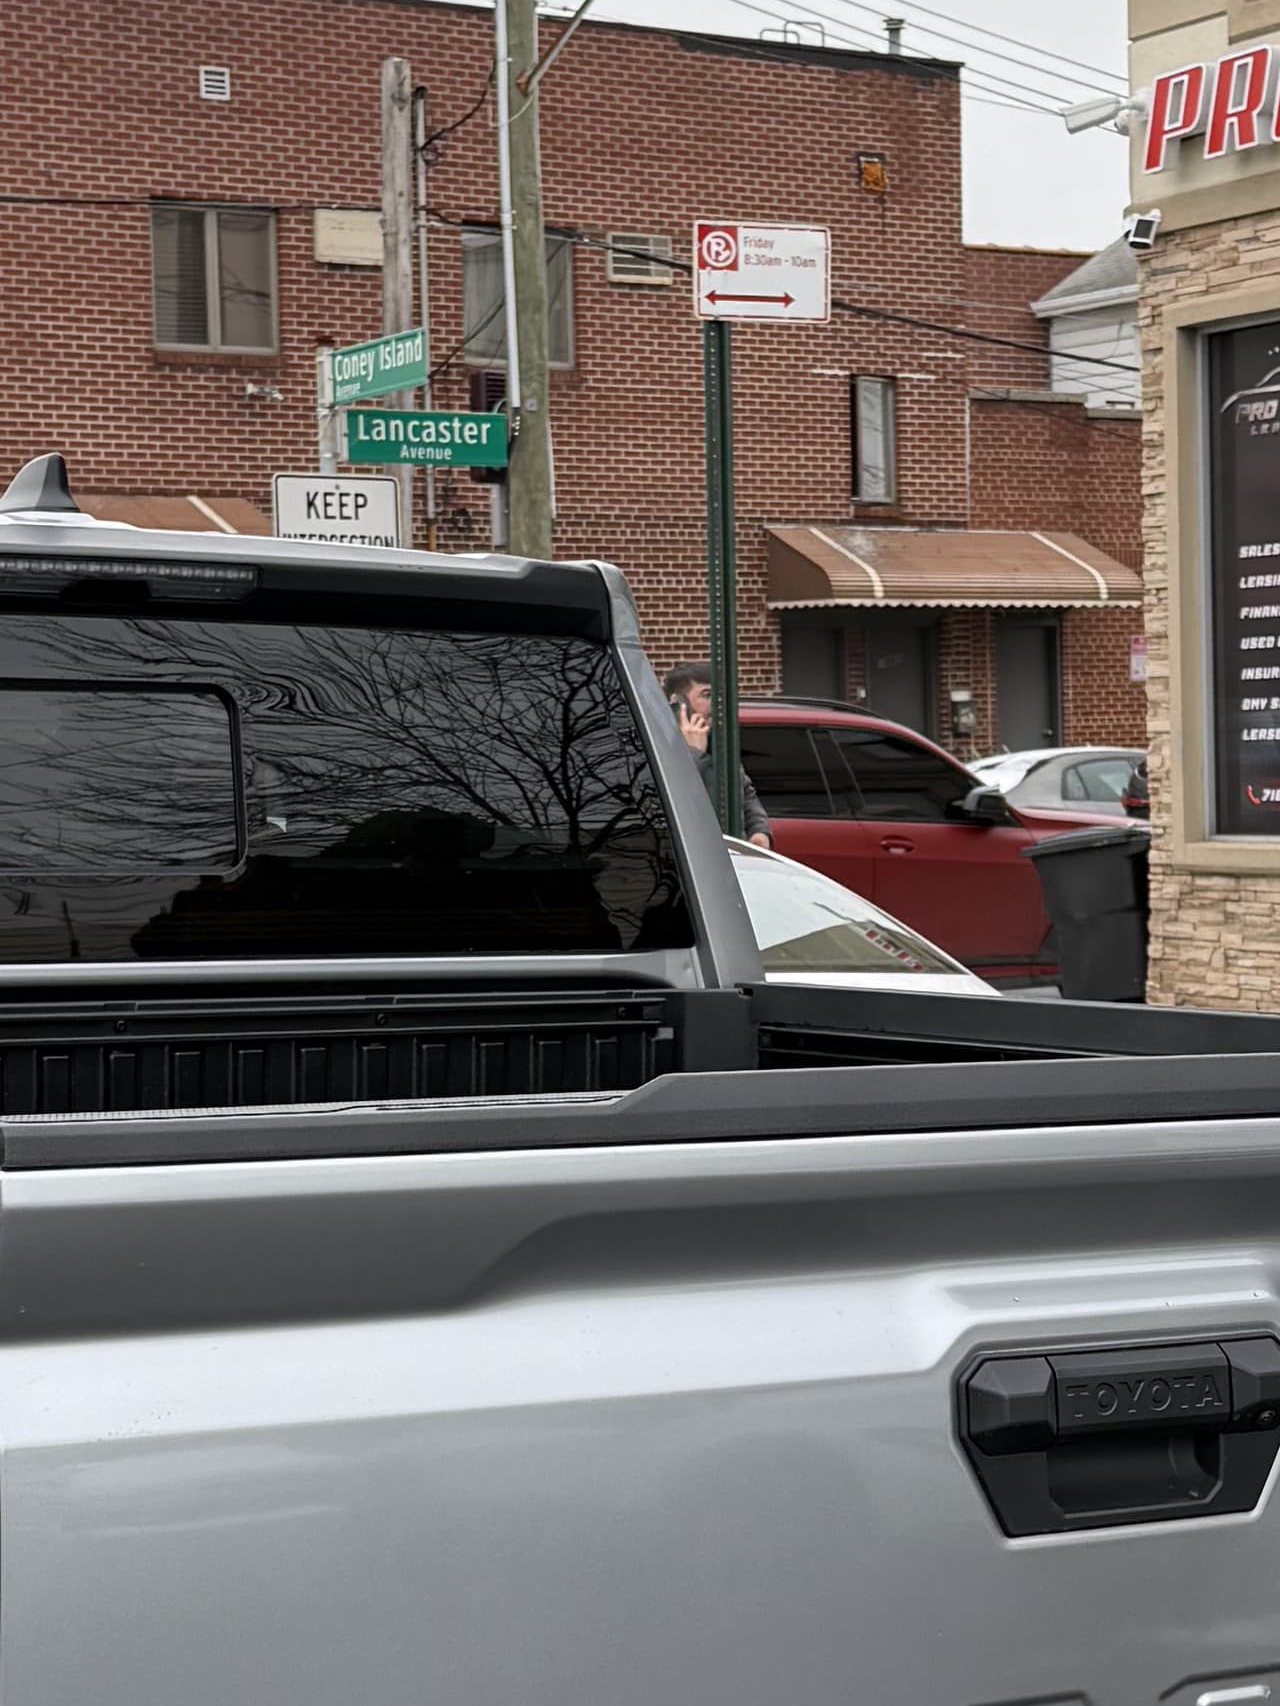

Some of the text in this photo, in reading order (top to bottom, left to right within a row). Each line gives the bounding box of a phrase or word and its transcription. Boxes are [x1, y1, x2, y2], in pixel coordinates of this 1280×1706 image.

[743, 236, 775, 251] Friday
[334, 332, 423, 382] Coney Island
[357, 413, 492, 445] Lancaster
[399, 444, 453, 461] Avenue
[305, 490, 369, 521] KEEP
[1240, 635, 1275, 650] USED
[1241, 697, 1268, 711] DMV
[1065, 1373, 1223, 1418] TOYOTA
